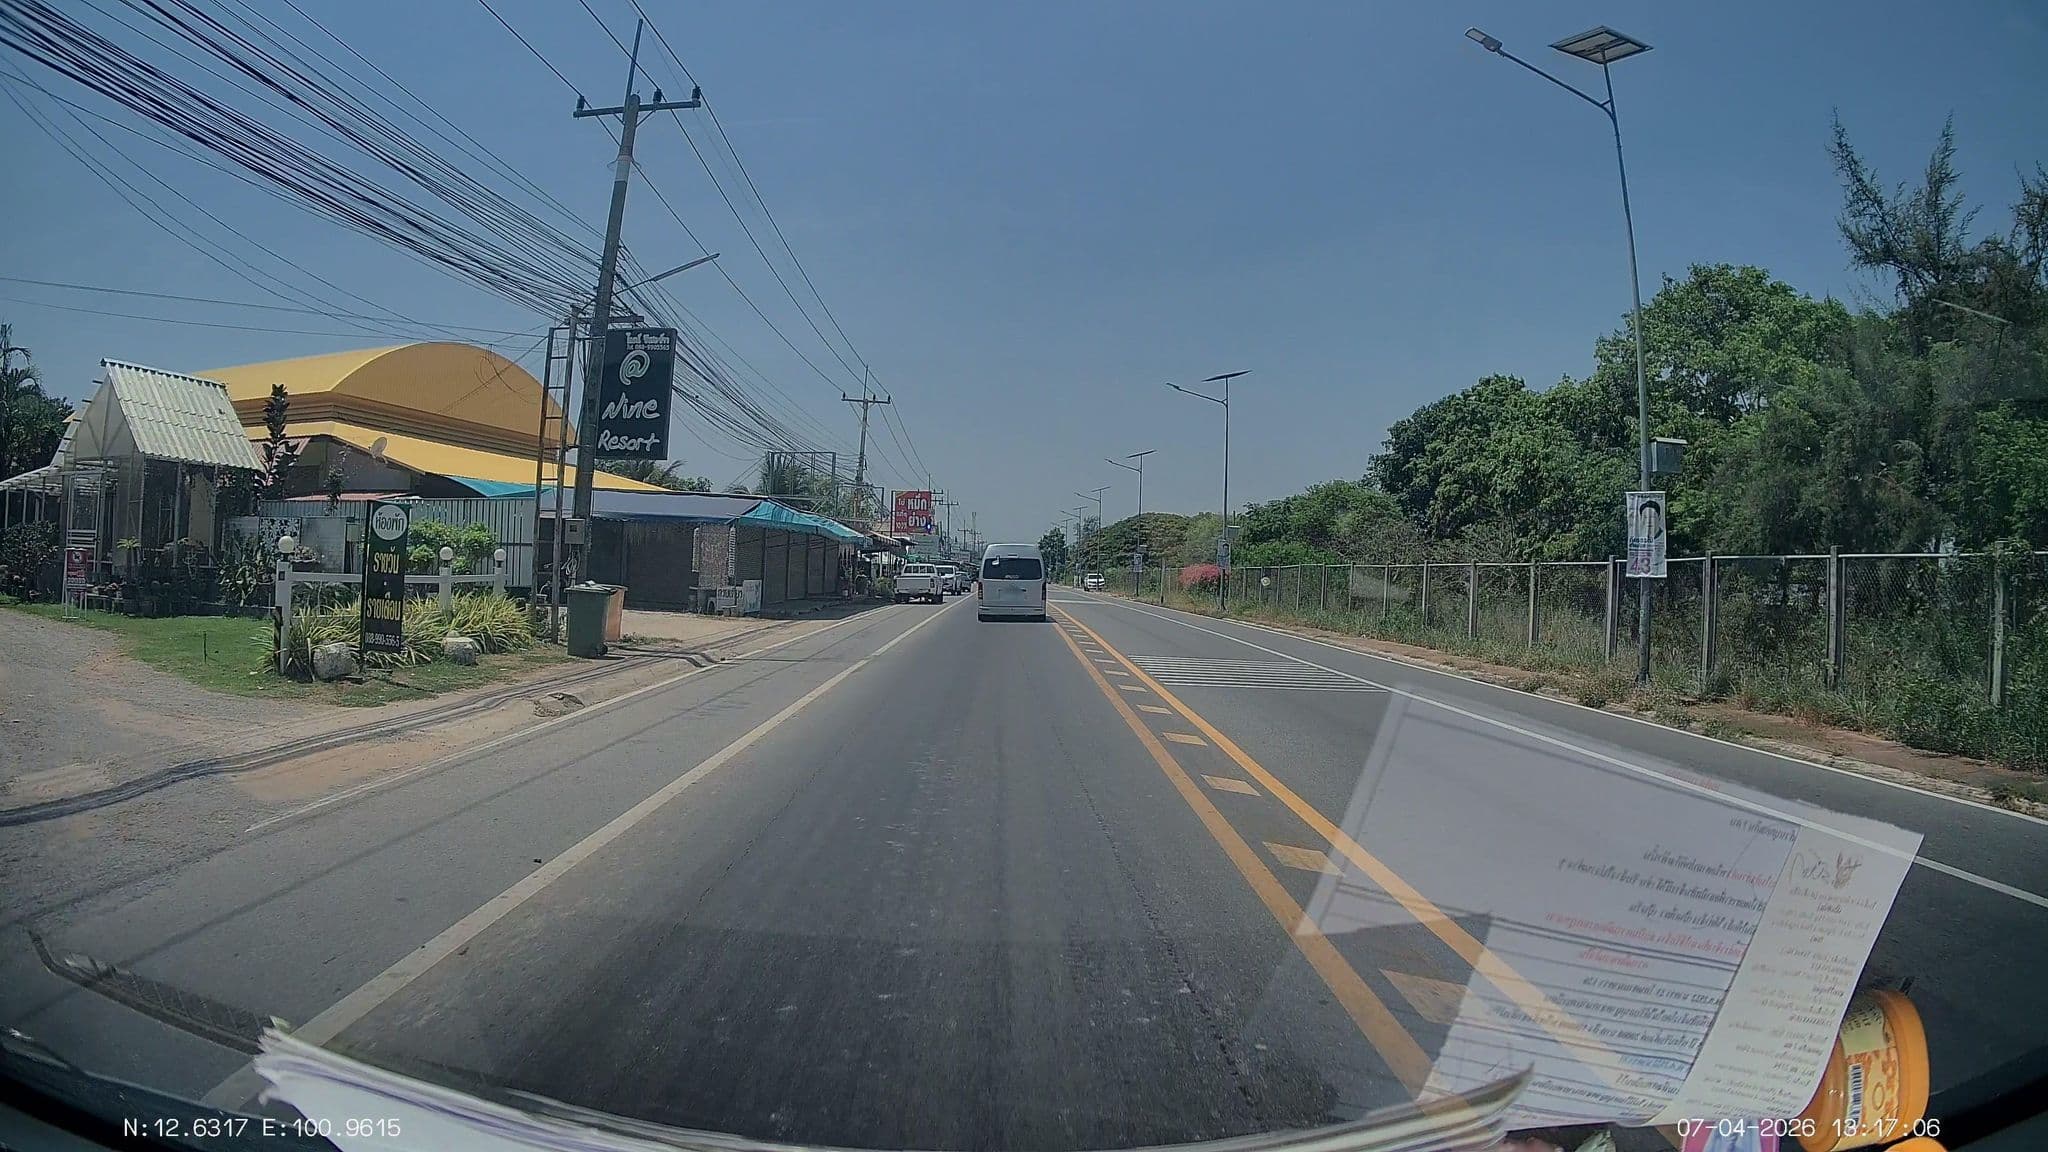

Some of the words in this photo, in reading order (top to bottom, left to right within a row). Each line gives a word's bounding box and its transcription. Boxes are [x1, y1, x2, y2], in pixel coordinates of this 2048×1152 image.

[601, 392, 661, 419] Nine
[597, 429, 660, 452] Resort
[375, 512, 404, 532] ห้องพัก
[908, 512, 927, 527] ย่าง
[373, 546, 400, 574] รายวัน
[366, 591, 402, 621] รายเดือน
